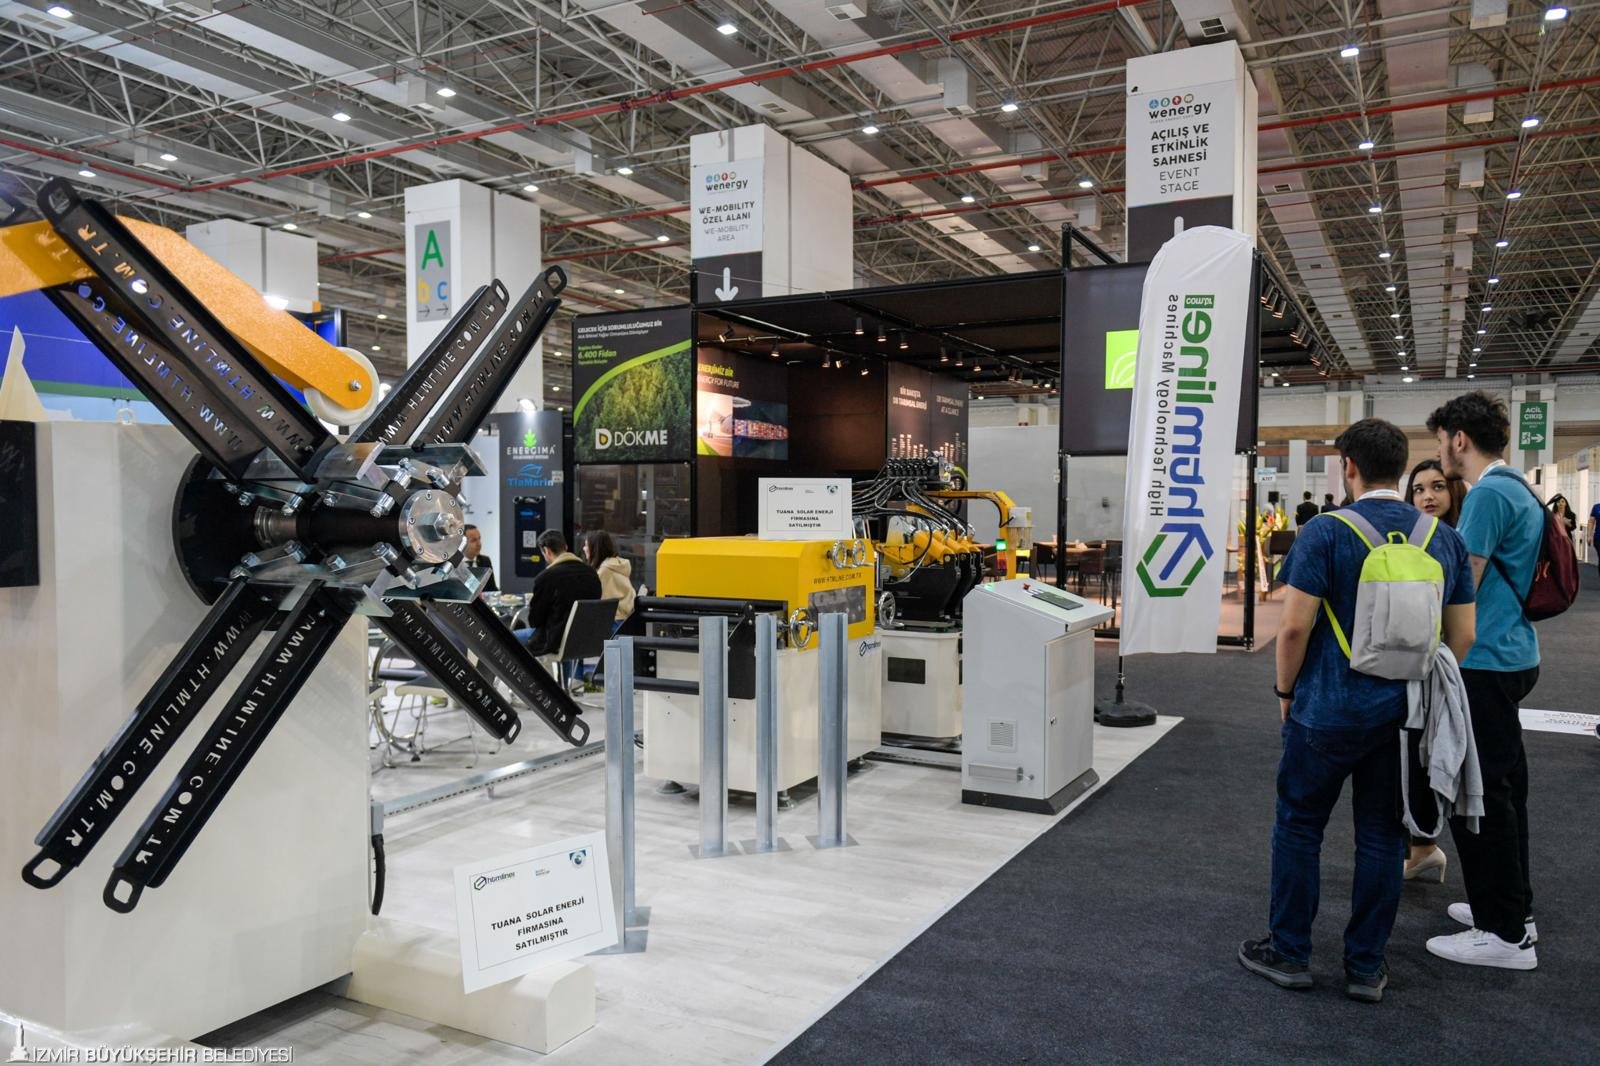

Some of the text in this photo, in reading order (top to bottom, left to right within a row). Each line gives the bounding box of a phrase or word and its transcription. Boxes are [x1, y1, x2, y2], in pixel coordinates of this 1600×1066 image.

[1148, 102, 1211, 119] wenergy
[1151, 123, 1209, 141] AÇILIŞ VE
[1152, 136, 1208, 154] ETKİNLİK
[1153, 148, 1206, 167] SAHNESİ
[1160, 167, 1200, 180] EVENT
[706, 180, 748, 191] wenergy
[1160, 181, 1199, 194] STAGE
[699, 201, 755, 214] WE-MOBILITY
[726, 212, 751, 221] ALANI
[421, 229, 444, 270] A
[437, 281, 448, 300] c
[578, 350, 617, 359] 6.400 Fidan
[614, 427, 668, 446] DÖKME
[66, 610, 253, 847] WWW.HTMLINE.COM.TR
[491, 896, 585, 931] TUANA SOLAR ENERJİ
[517, 917, 564, 936] FİRMASINA
[515, 928, 569, 951] SATILMIŞTIR
